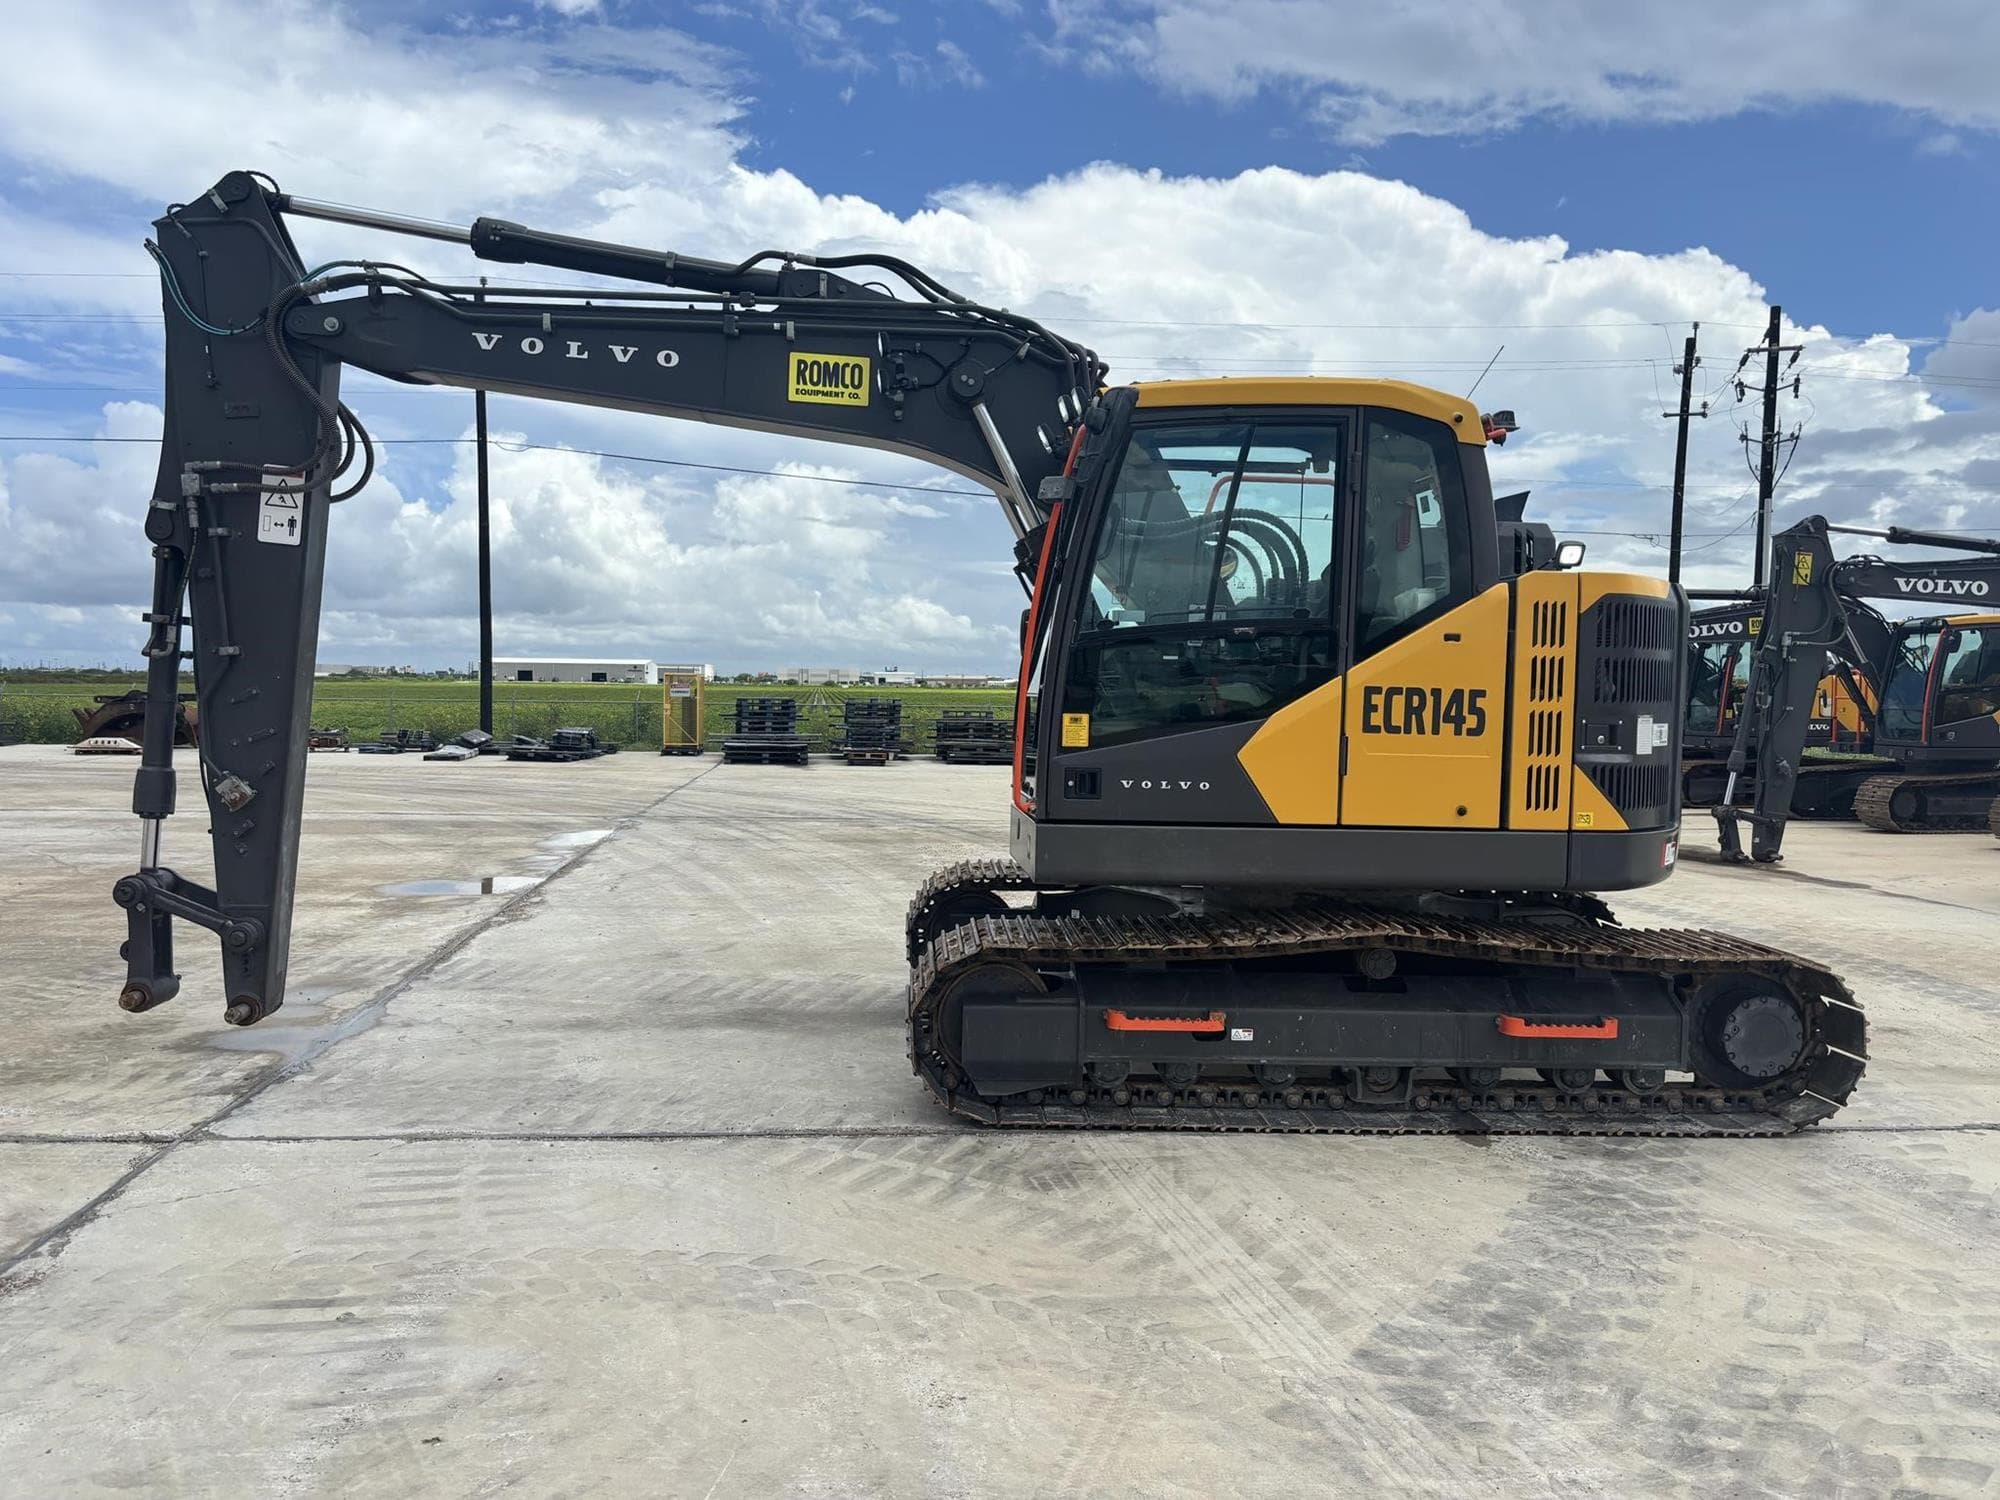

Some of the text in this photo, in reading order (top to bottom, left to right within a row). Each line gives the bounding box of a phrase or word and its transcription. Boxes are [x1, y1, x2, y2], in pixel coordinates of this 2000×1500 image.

[472, 332, 680, 367] VOLVO
[796, 359, 864, 390] ROMCO
[795, 388, 861, 400] EQUIPMENT CO.
[1894, 577, 1989, 596] VOLVO
[1362, 685, 1487, 737] ECR145
[1120, 780, 1210, 790] VOLVO
